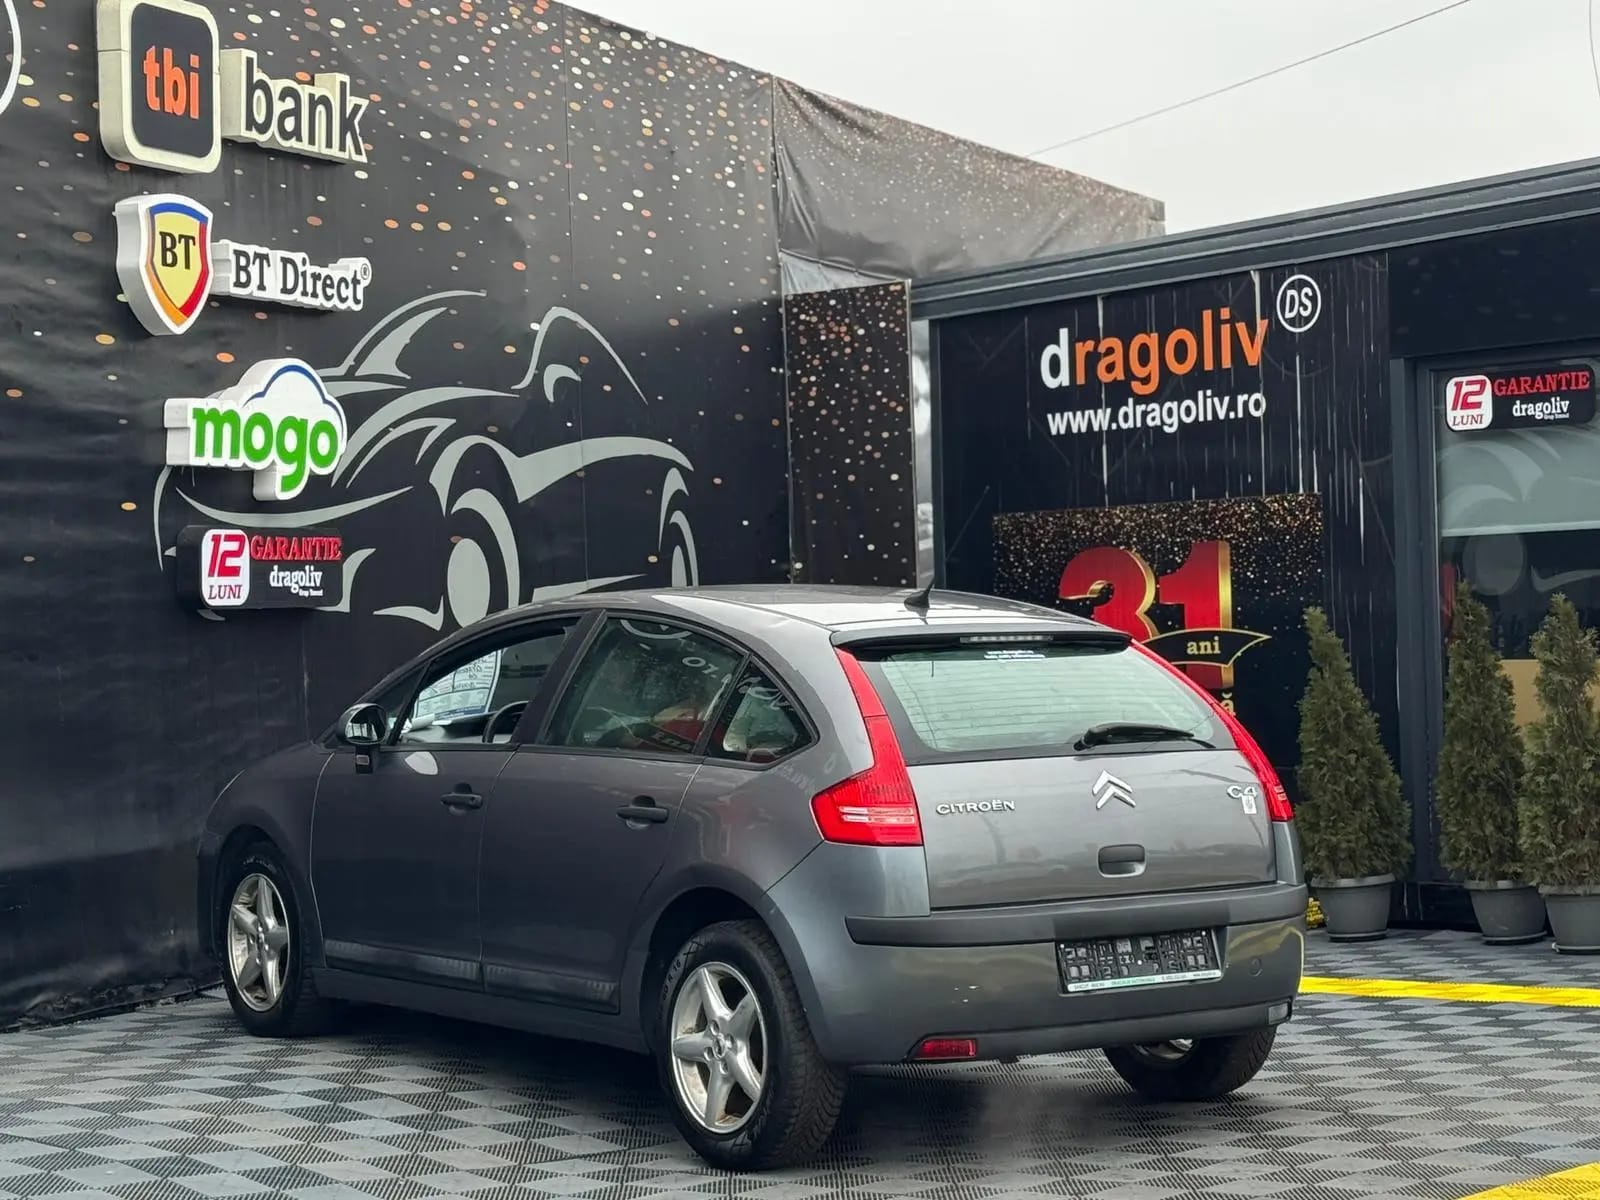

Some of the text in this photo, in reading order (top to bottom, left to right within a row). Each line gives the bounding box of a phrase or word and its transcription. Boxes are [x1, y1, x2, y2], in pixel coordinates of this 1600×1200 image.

[143, 45, 364, 157] tbi bank
[159, 231, 196, 270] BT
[232, 249, 271, 288] BT
[1284, 286, 1313, 319] DS
[1040, 307, 1269, 395] dragoliv
[1451, 379, 1487, 411] 12
[1493, 371, 1590, 397] GARANTIE
[1047, 389, 1267, 435] www.dragoliv.ro
[1452, 414, 1484, 427] LUNI
[1512, 396, 1570, 420] dragoliv
[192, 406, 338, 493] mogo
[208, 534, 246, 578] 12
[250, 535, 342, 561] GARANTIE
[208, 584, 242, 600] LUNI
[269, 565, 323, 593] dragoliv
[1058, 539, 1235, 689] 31
[1186, 636, 1221, 655] ani
[936, 799, 1016, 815] CITROËN
